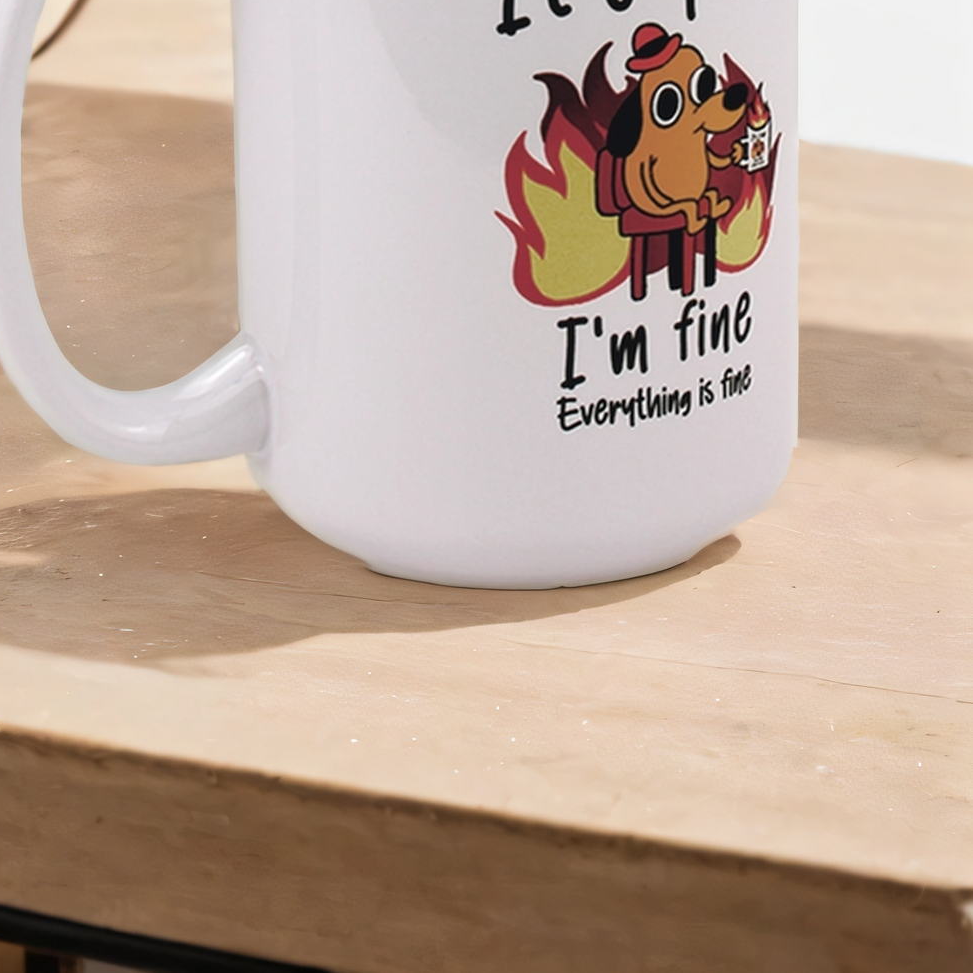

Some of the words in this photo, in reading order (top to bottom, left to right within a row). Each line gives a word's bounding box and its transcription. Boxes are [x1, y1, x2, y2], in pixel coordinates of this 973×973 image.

[556, 315, 648, 390] I'm
[673, 291, 752, 362] fine
[556, 386, 692, 432] Everything
[698, 377, 715, 407] is
[720, 364, 752, 400] fine
